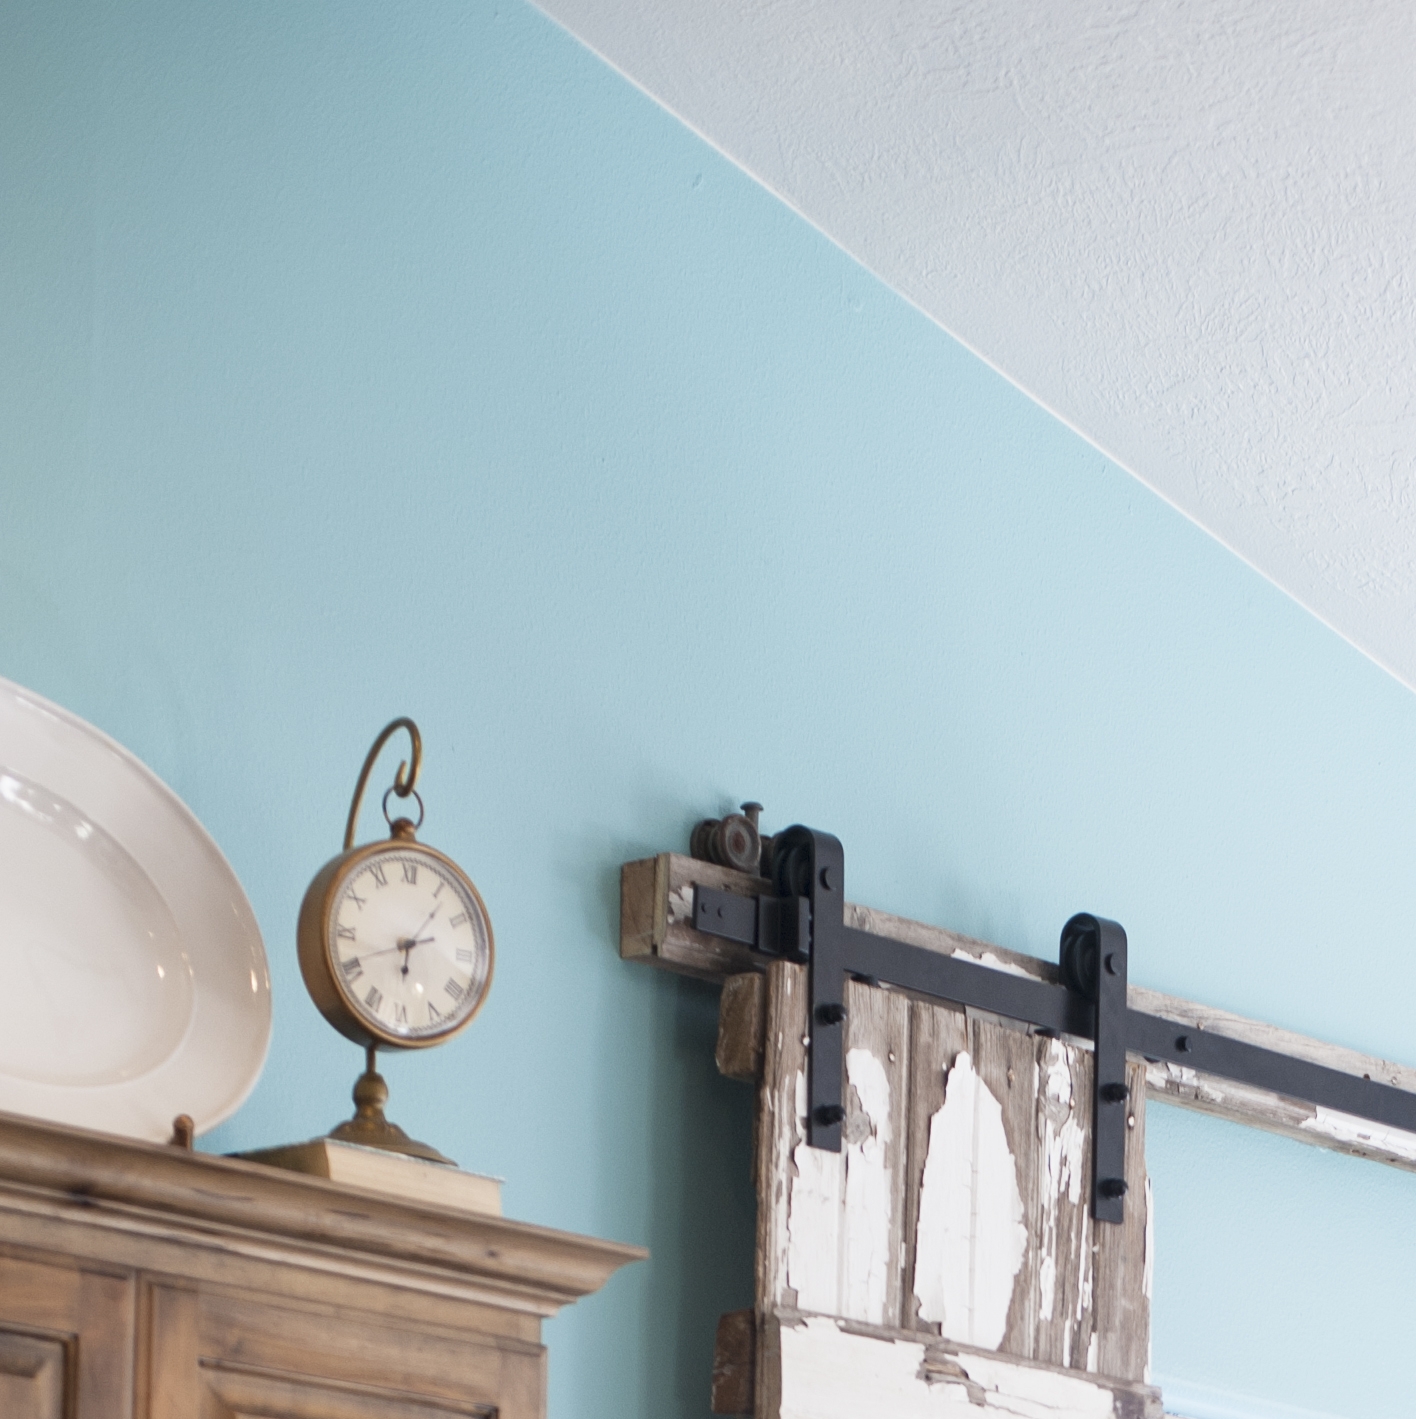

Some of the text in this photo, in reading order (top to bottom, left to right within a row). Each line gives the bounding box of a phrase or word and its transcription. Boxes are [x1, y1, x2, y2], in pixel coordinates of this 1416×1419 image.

[369, 862, 388, 888] XI
[401, 862, 418, 886] XII
[347, 886, 366, 911] X
[432, 882, 444, 898] I
[449, 912, 467, 929] II
[338, 923, 356, 941] IX
[456, 948, 473, 963] III
[427, 1001, 441, 1021] V
